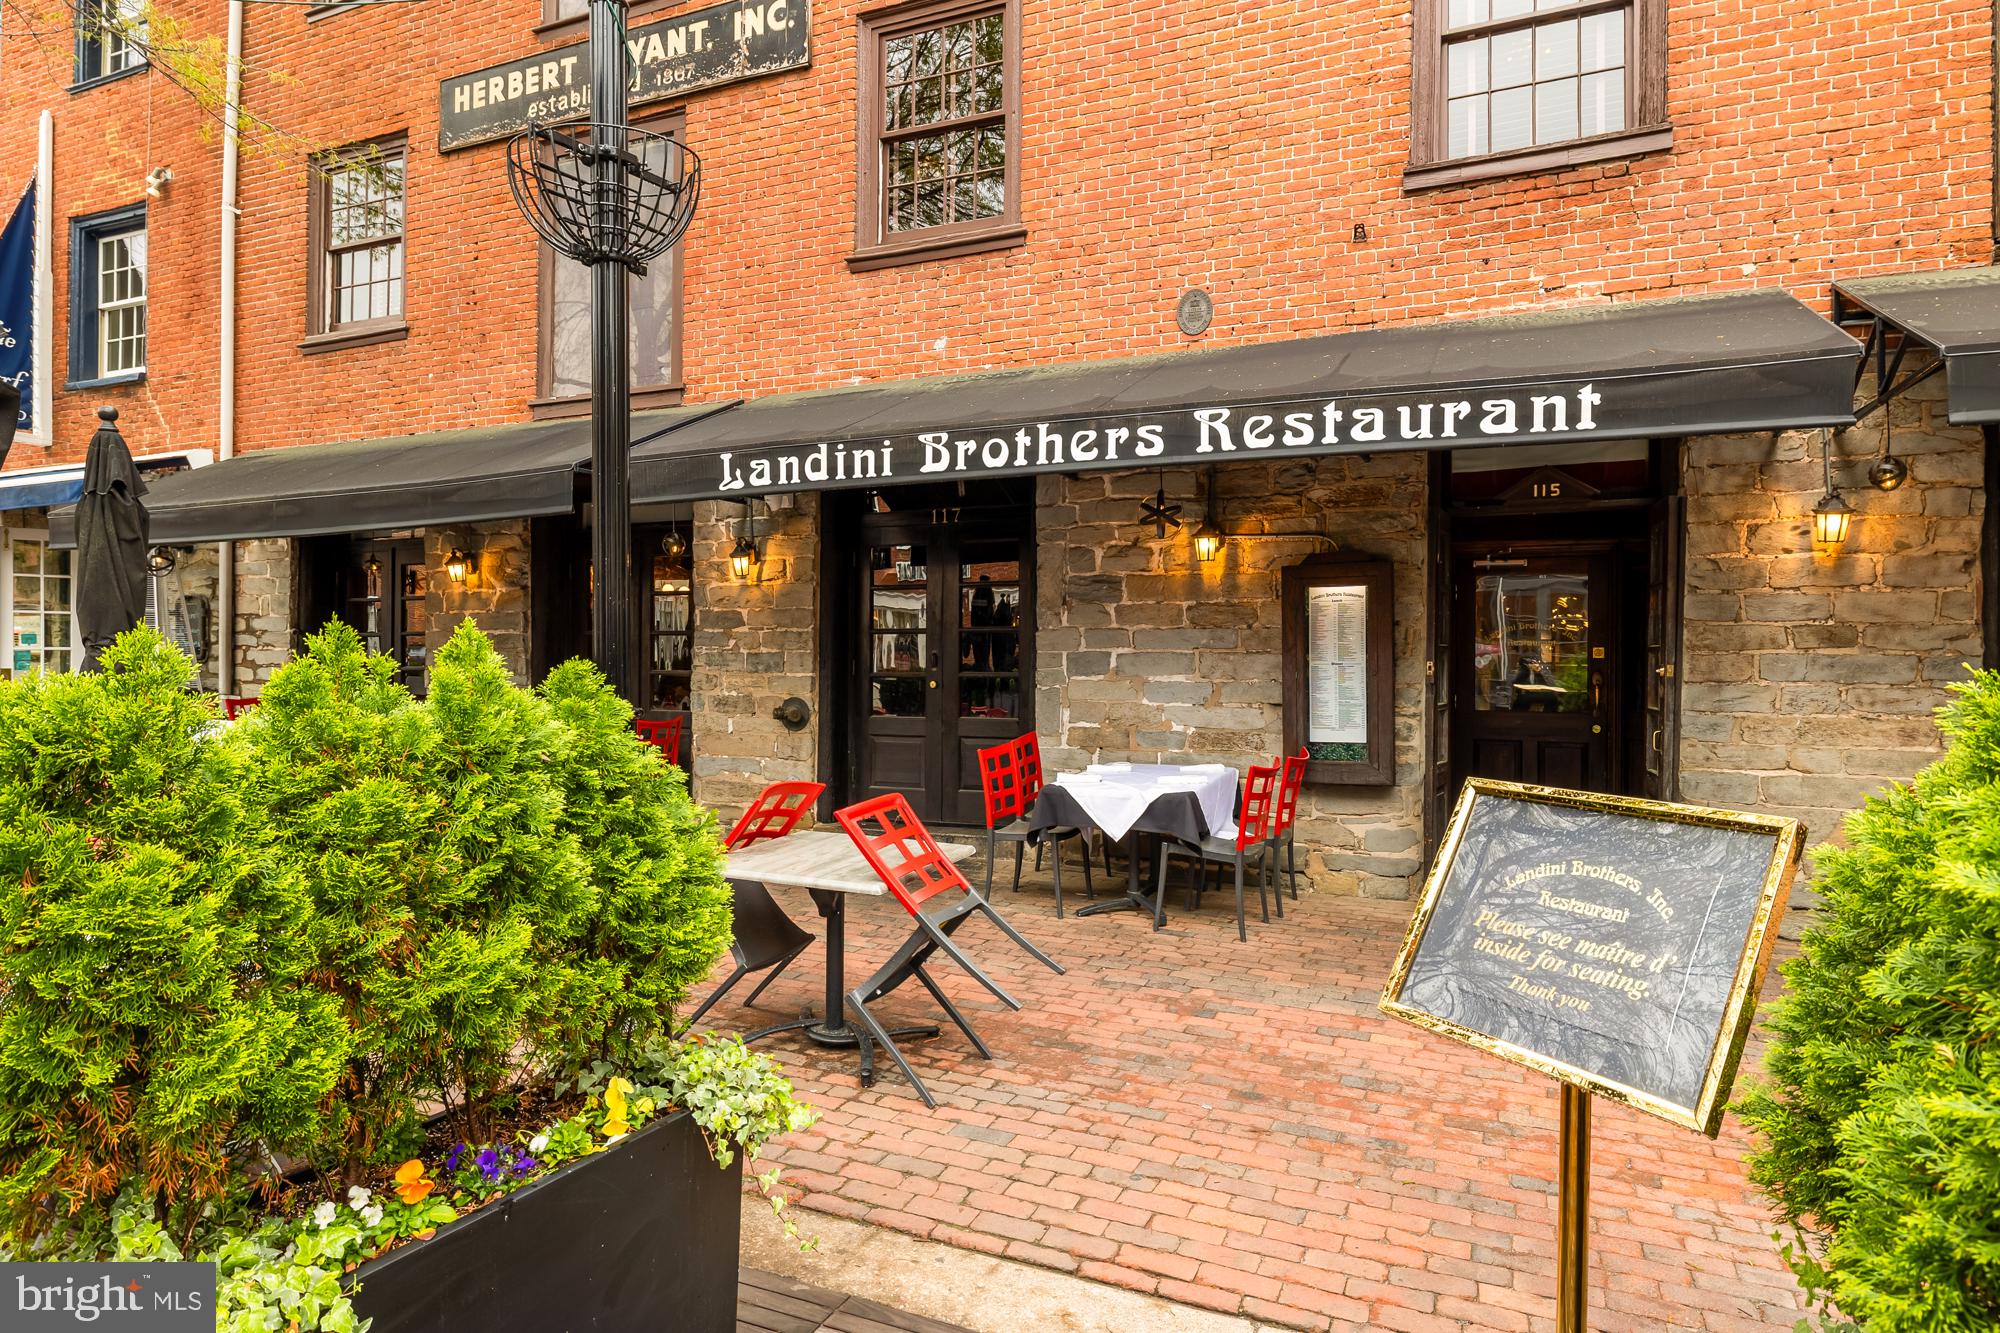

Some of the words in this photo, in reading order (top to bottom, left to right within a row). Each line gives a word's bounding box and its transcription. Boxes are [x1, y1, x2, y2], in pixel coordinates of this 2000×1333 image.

[454, 55, 578, 113] HERBERT
[734, 0, 795, 41] INC.
[656, 62, 695, 87] 1867
[718, 440, 894, 492] Landini
[917, 423, 1165, 474] Brothers
[1192, 382, 1602, 454] Restaurant
[1532, 482, 1561, 498] 115
[930, 507, 961, 525] 117
[1503, 861, 1567, 890] Landini
[1571, 860, 1643, 896] Brothers,
[1538, 890, 1630, 924] Restaurant
[1473, 909, 1538, 941] Please
[1538, 929, 1573, 951] see
[1573, 938, 1647, 969] maître
[1473, 931, 1532, 963] inside
[1526, 949, 1569, 973] for
[1568, 967, 1650, 1001] seating.
[1507, 975, 1557, 1002] Thank
[1555, 993, 1594, 1013] you
